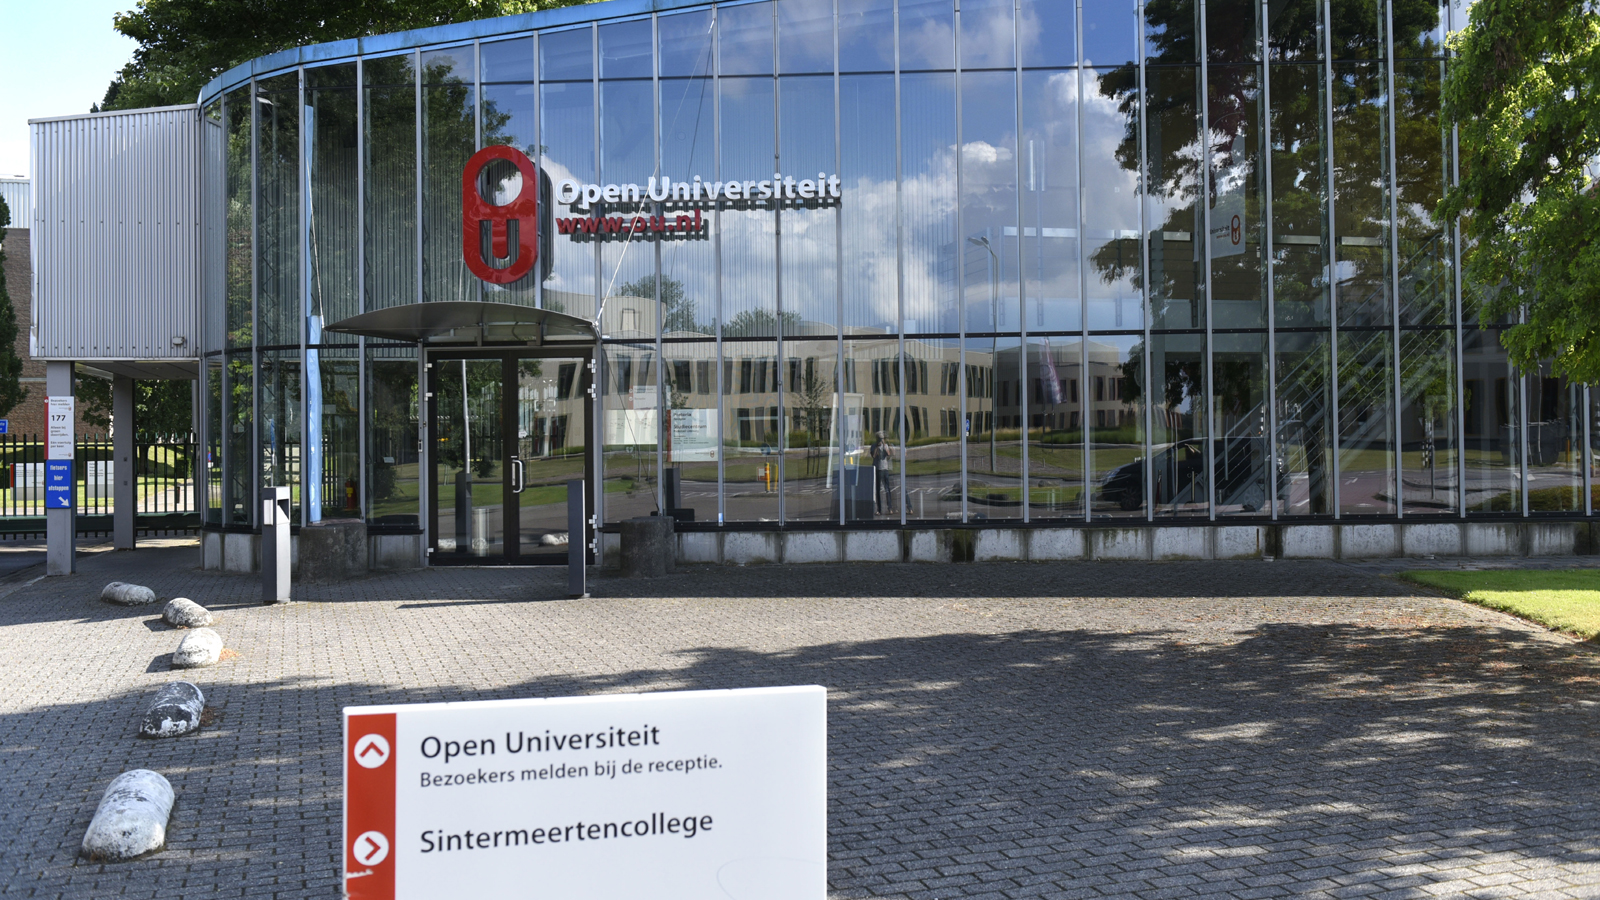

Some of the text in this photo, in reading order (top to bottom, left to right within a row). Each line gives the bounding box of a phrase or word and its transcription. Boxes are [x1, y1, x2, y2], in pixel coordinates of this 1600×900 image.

[556, 172, 840, 209] Open Universiteit
[556, 208, 700, 234] www.ou.nl
[420, 724, 661, 763] Open Universiteit
[420, 754, 723, 788] Bezoekers melden bij de receptie.
[420, 811, 714, 854] Sintermeertencollege
